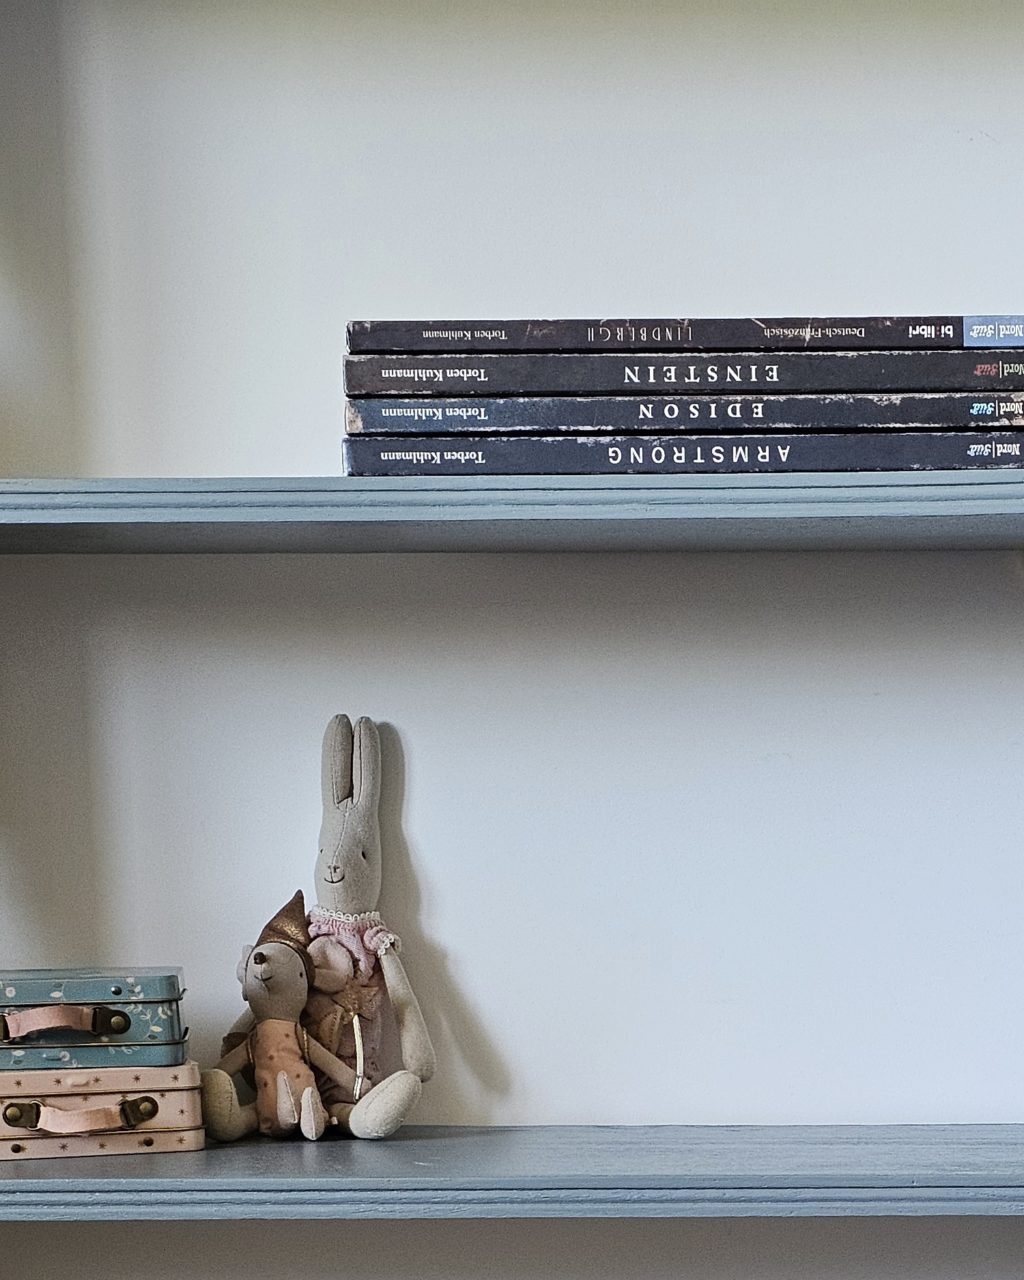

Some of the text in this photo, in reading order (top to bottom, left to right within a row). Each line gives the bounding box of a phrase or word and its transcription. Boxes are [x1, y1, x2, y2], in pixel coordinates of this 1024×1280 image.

[422, 330, 508, 340] Torben Kuhlmann
[381, 369, 489, 382] Torben Kuhlmann
[623, 365, 780, 383] EINSTEIN
[381, 408, 489, 421] Torben Kuhlmann
[638, 403, 765, 419] EDISON
[380, 451, 487, 464] Torben Kuhlmann
[608, 445, 791, 465] ARMSTRONG
